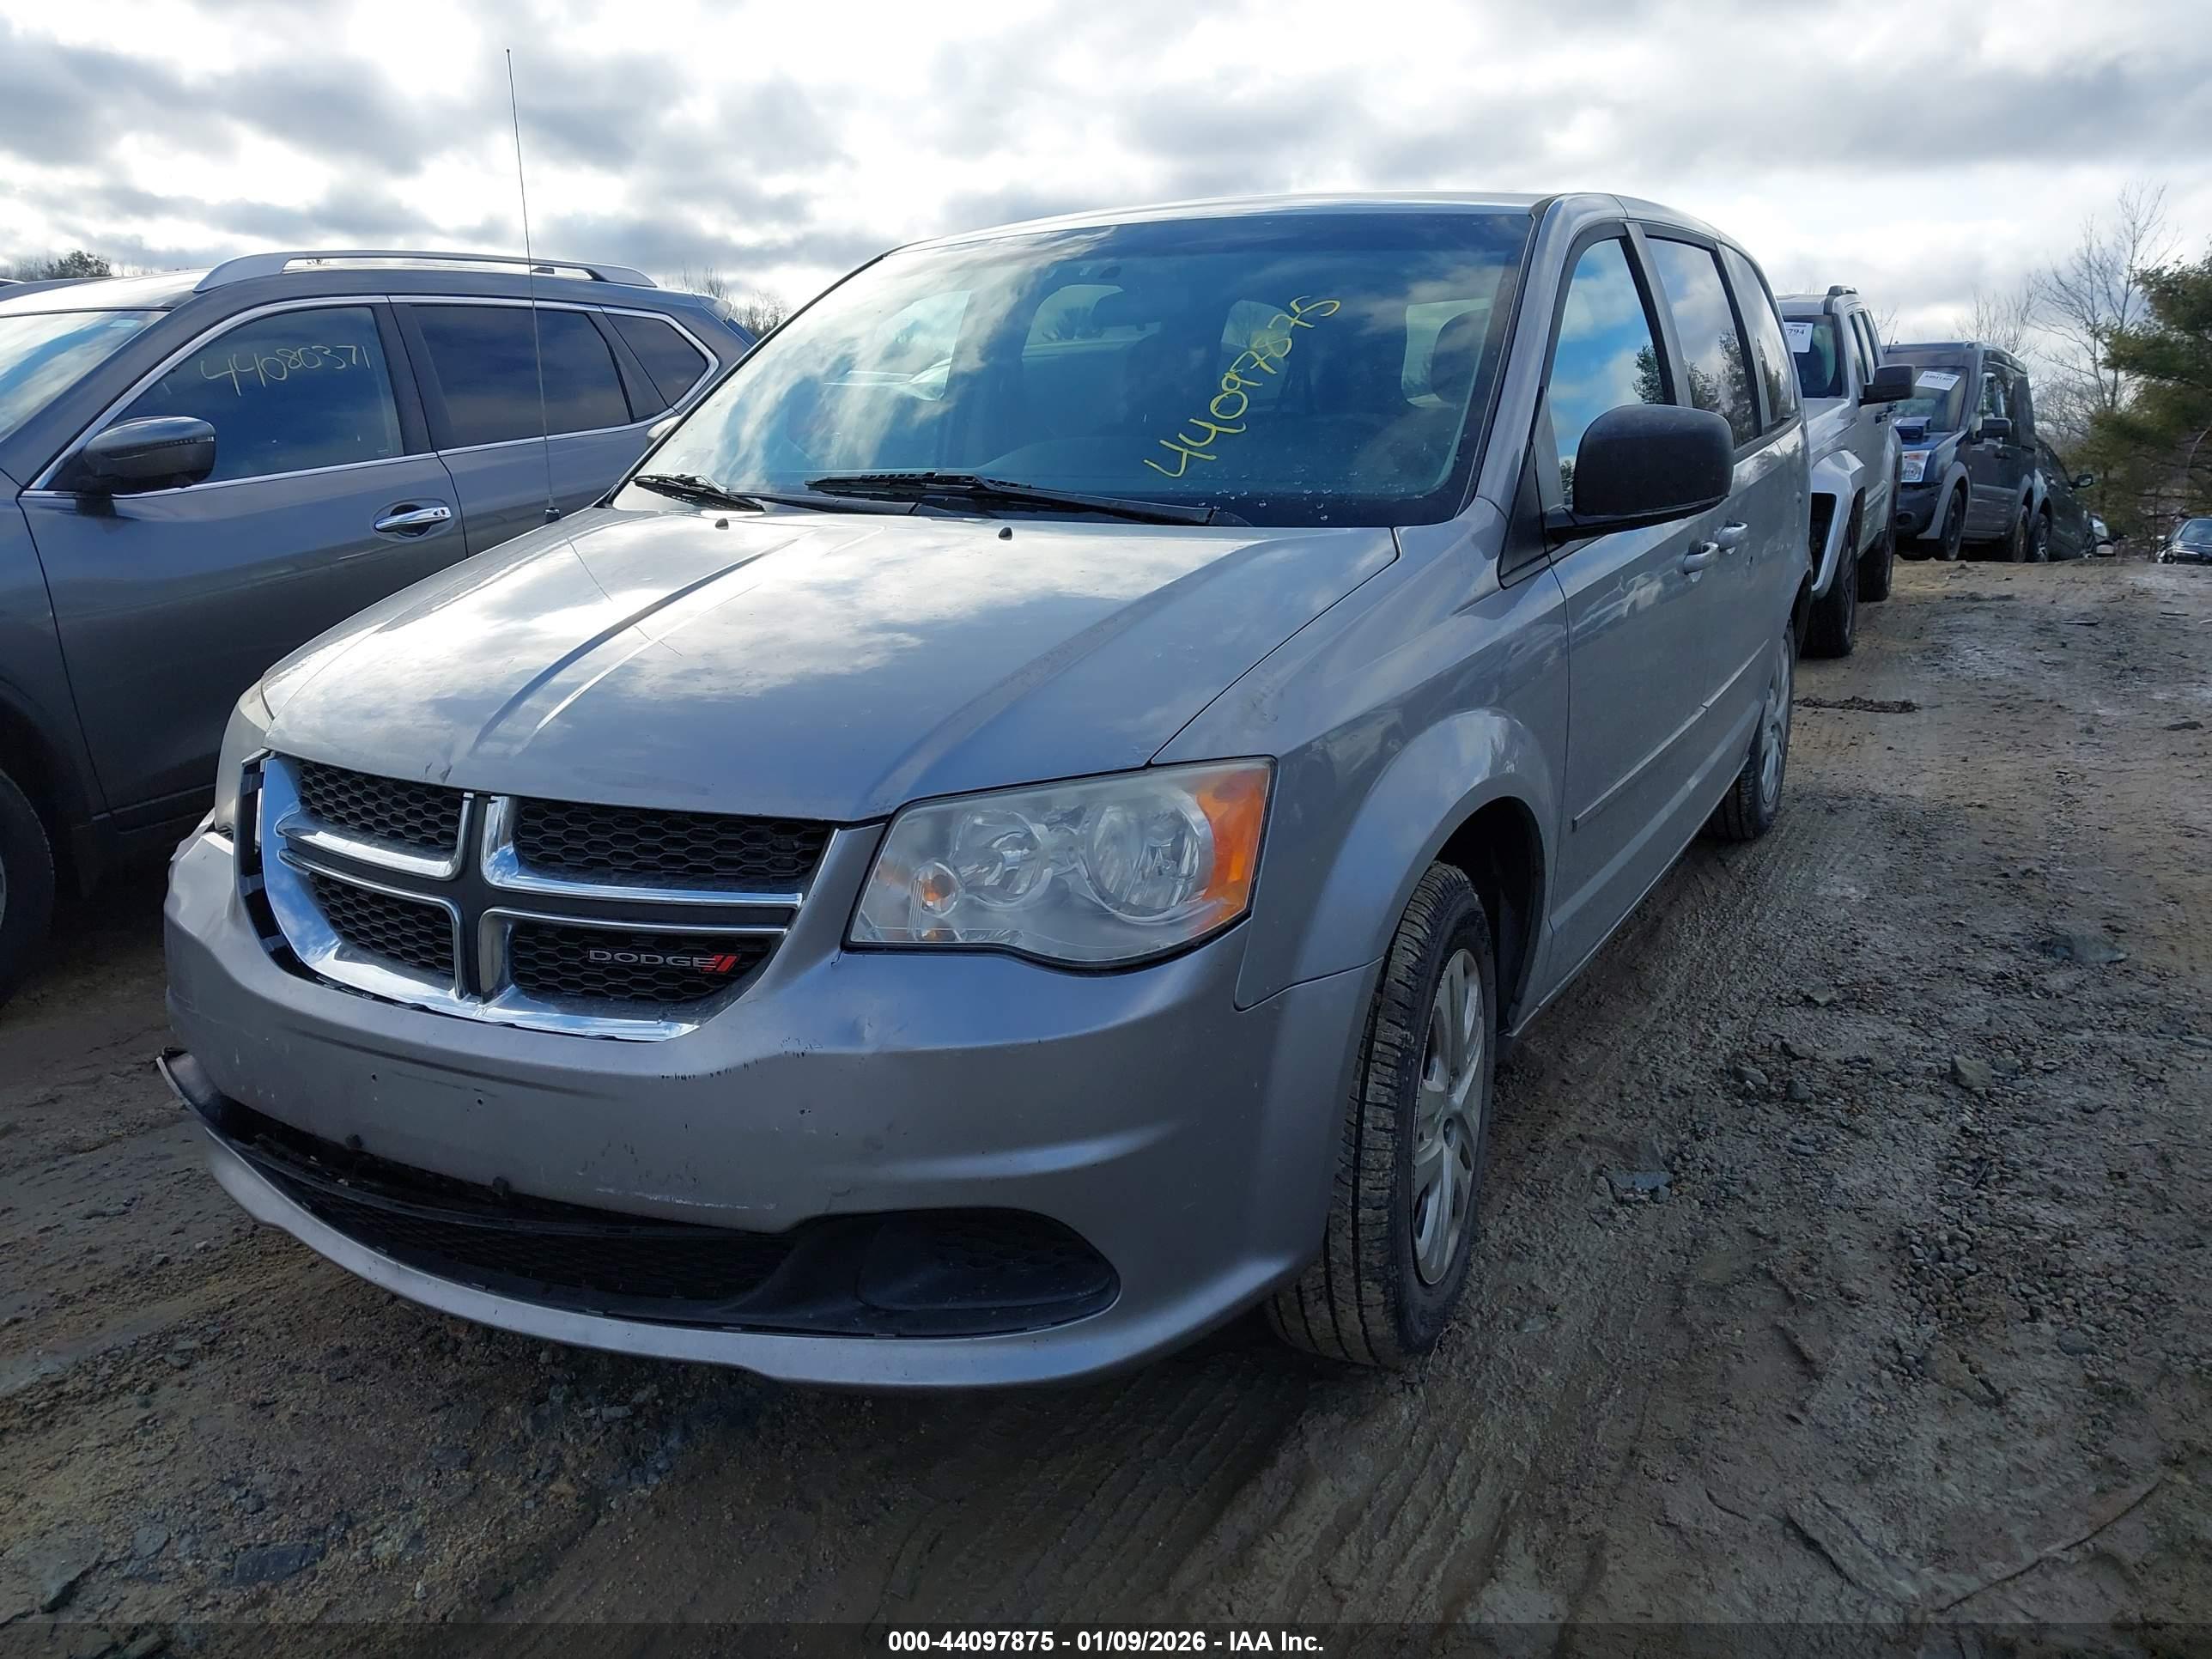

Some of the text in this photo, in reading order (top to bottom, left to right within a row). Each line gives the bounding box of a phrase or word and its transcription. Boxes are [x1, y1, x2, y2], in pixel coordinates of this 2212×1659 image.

[199, 345, 371, 397] 44080371
[1144, 295, 1340, 478] 44097875
[589, 950, 717, 969] DODGE
